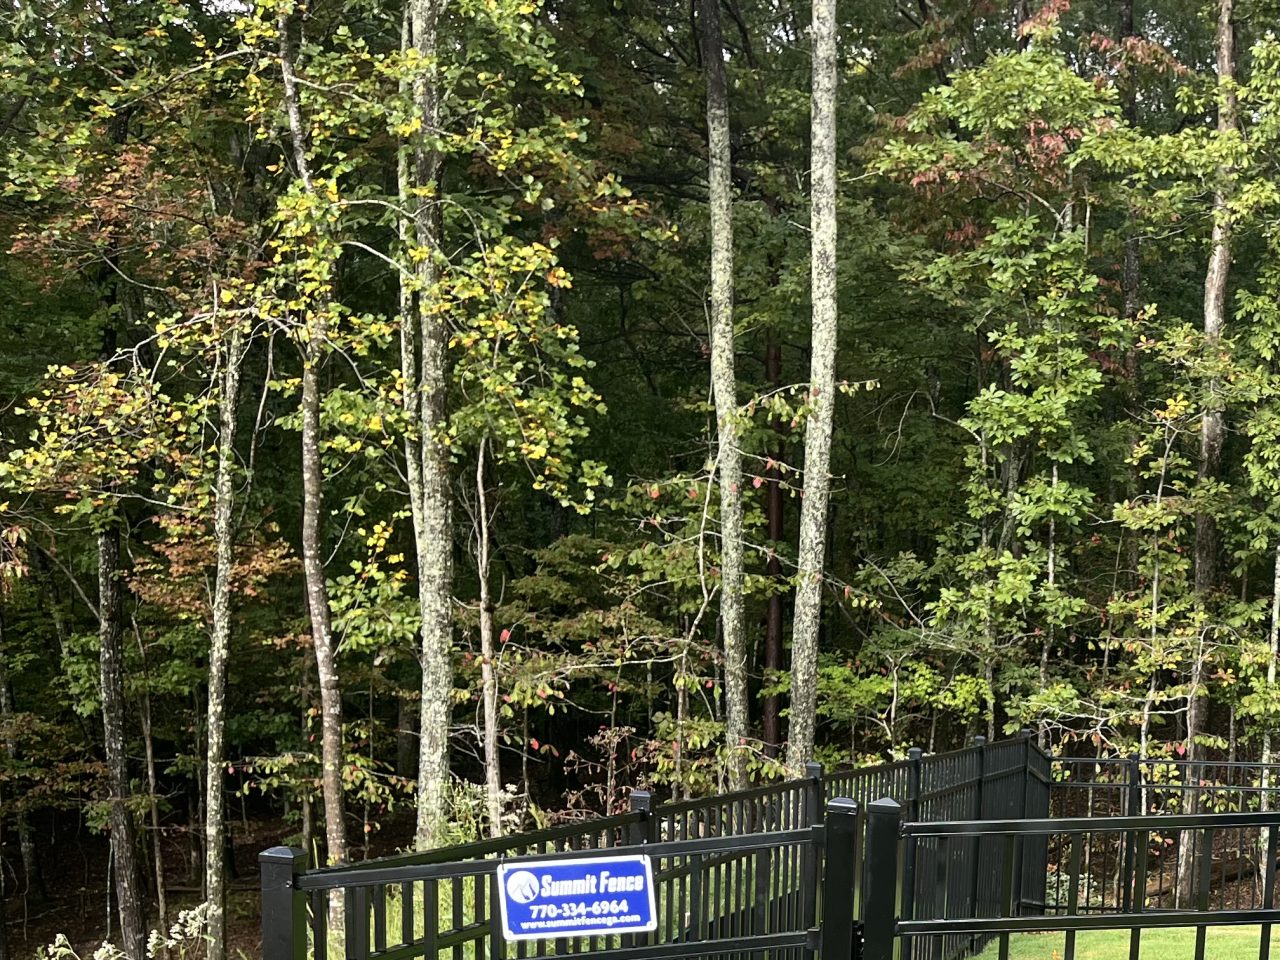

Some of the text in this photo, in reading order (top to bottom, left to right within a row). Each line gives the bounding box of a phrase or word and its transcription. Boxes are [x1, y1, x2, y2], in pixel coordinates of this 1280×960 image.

[540, 871, 644, 898] Summit Fence
[529, 899, 629, 919] 770-334-6964
[520, 914, 641, 930] www.summitfencega.com
